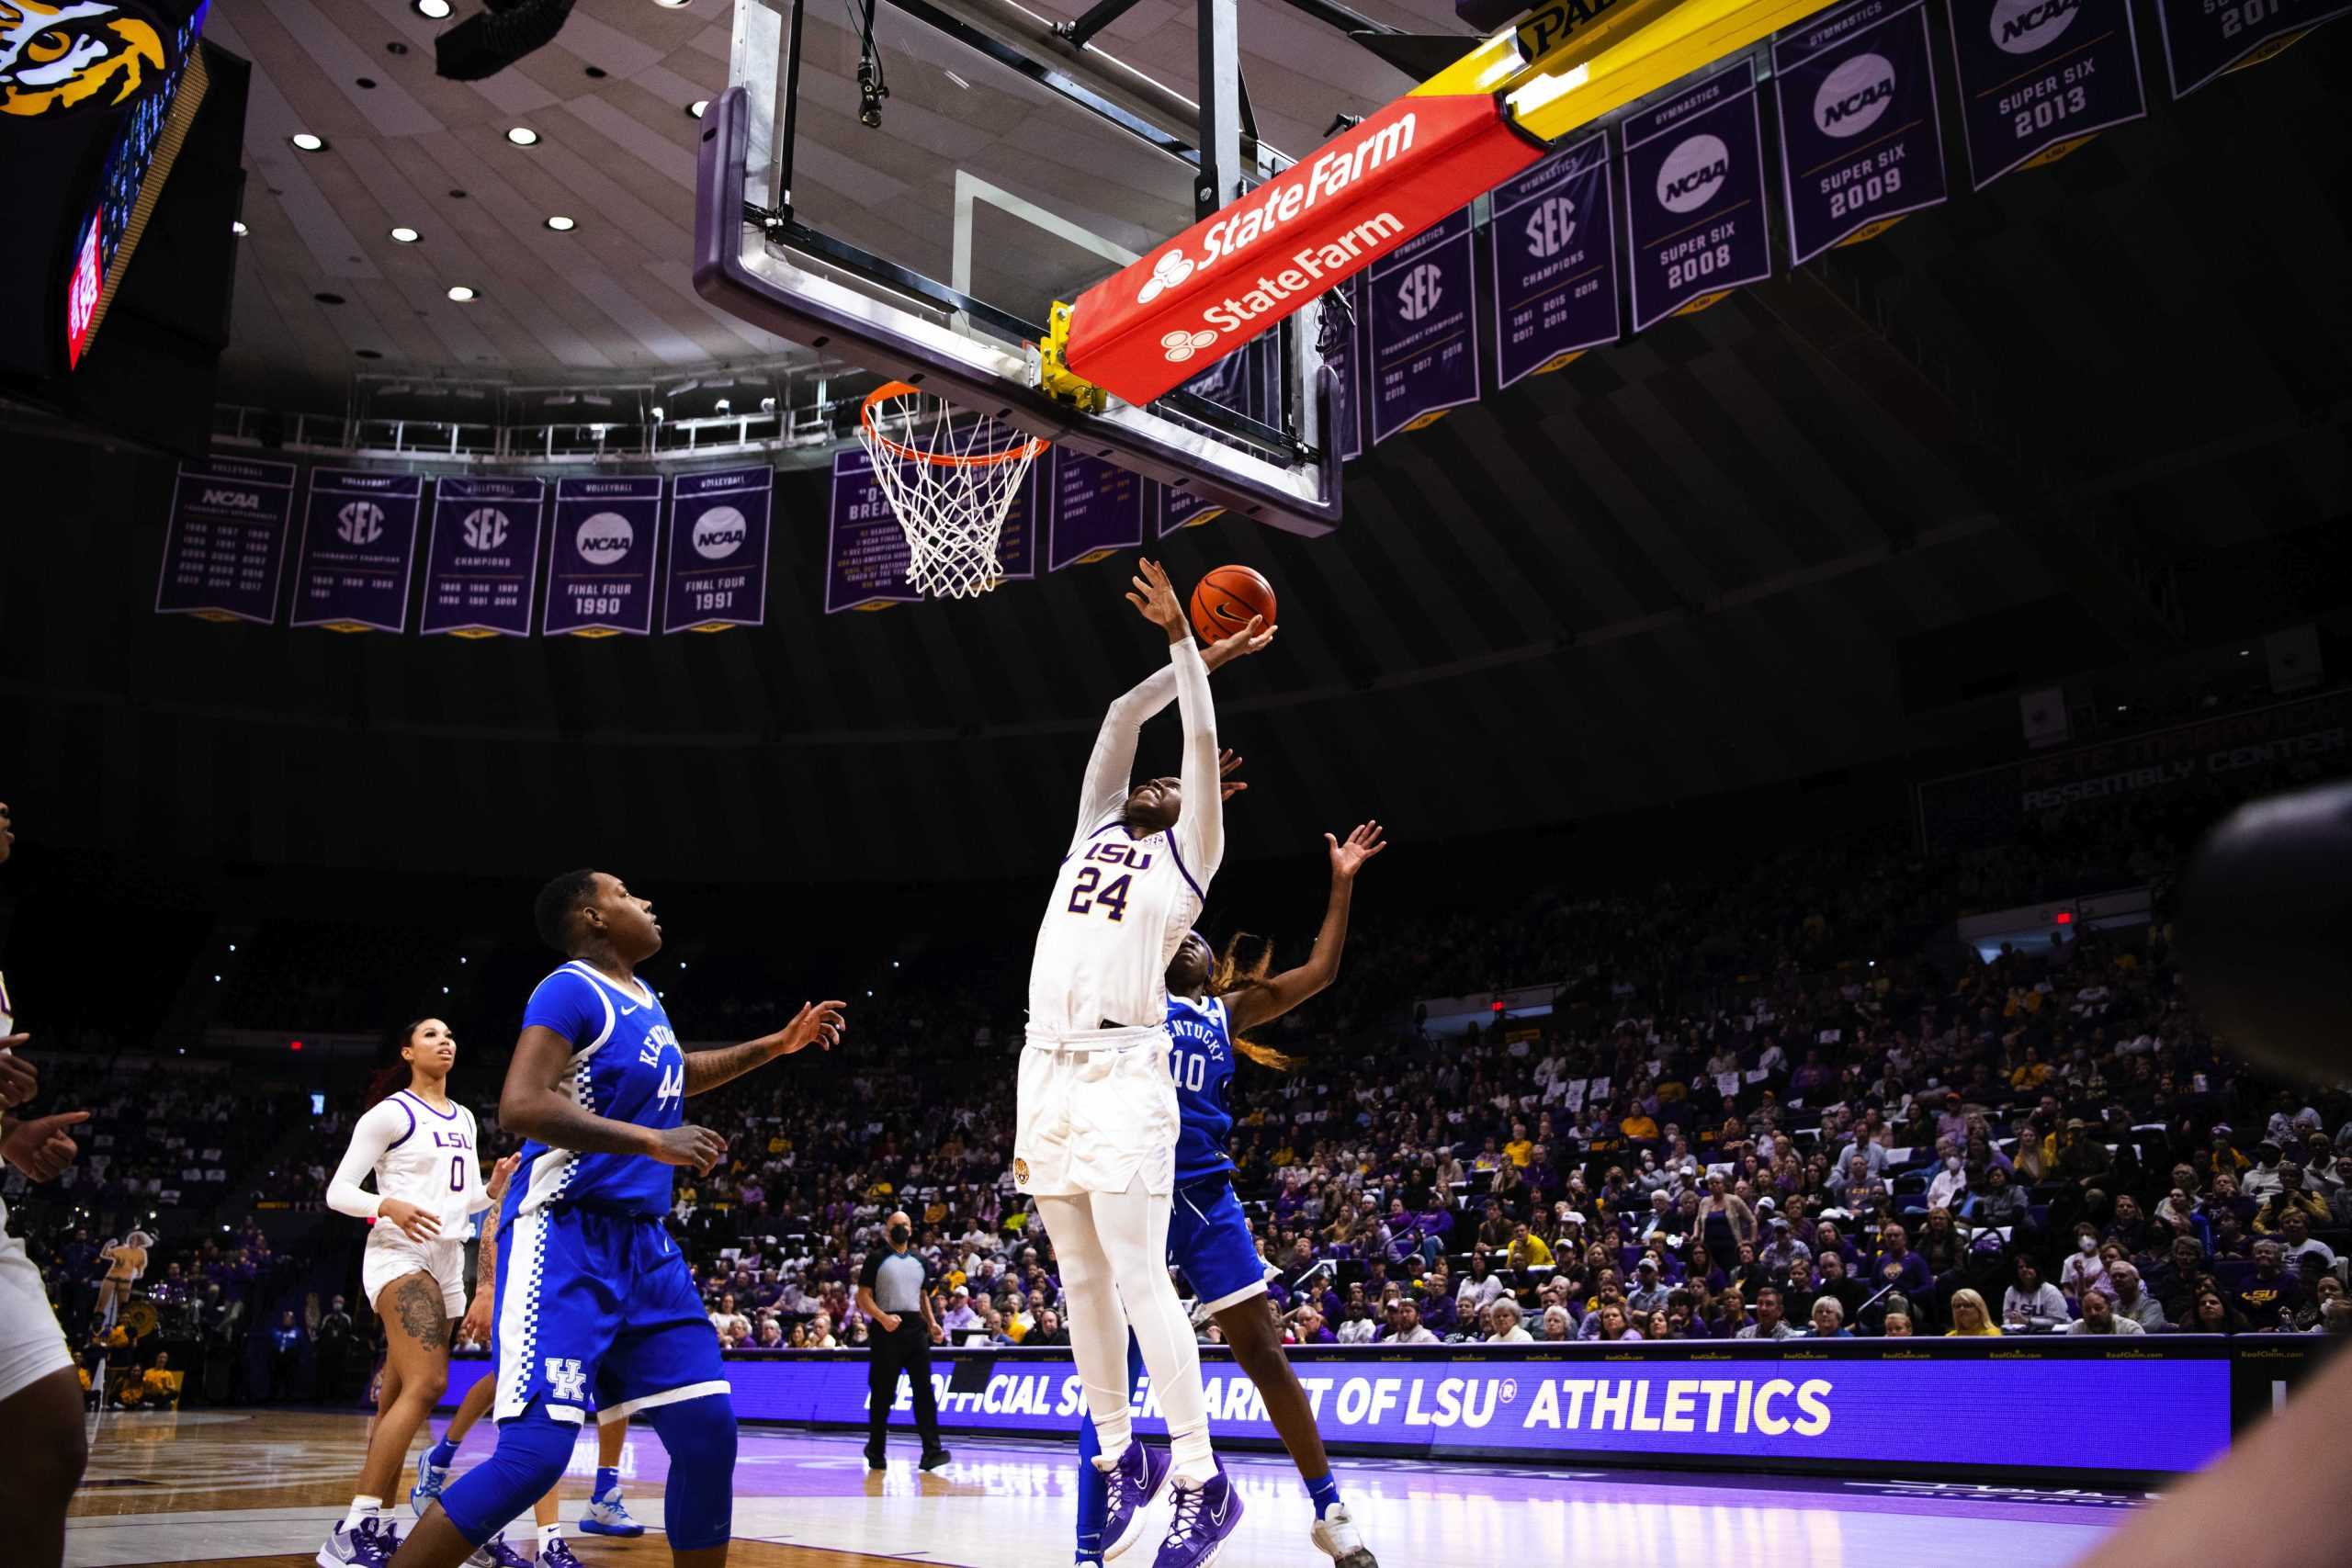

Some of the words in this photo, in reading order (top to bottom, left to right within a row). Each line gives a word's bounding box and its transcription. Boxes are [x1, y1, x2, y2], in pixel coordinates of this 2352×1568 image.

[1809, 2, 1883, 47] GYMNASTICS
[1655, 85, 1721, 126] GYMNASTICS
[1824, 77, 1893, 129] NCAA
[1999, 73, 2057, 117] SUPER
[2063, 57, 2096, 87] SIX
[2014, 85, 2087, 140] 2013
[1664, 157, 1726, 203] NCAA
[1820, 158, 1873, 196] SUPER
[1877, 142, 1907, 169] SIX
[1828, 166, 1903, 220] 2009
[1394, 225, 1445, 259] GYMNASTICS
[1525, 197, 1577, 258] SEC
[1659, 233, 1707, 266] SUPER
[1710, 220, 1736, 244] SIX
[1522, 249, 1586, 288] CHAMPIONS
[1667, 243, 1732, 289] 2008
[1397, 263, 1442, 321] SEC
[201, 489, 260, 511] NCAA
[585, 482, 633, 493] VOLLEYBALL
[700, 474, 745, 490] VOLLEYBALL
[336, 500, 386, 546] SEC
[462, 507, 511, 551] SEC
[582, 536, 632, 551] NCAA
[697, 529, 744, 547] NCAA
[454, 556, 512, 568] CHAMPIONS
[567, 583, 600, 596] FINAL
[602, 583, 632, 596] FOUR
[685, 579, 716, 593] FINAL
[718, 575, 746, 591] FOUR
[695, 591, 733, 612] 1991
[575, 597, 622, 615] 1990
[1084, 841, 1153, 871] LSU
[1066, 865, 1135, 923] 24
[1163, 1019, 1225, 1063] ENTUCKY
[656, 1064, 684, 1112] 44
[1173, 1049, 1206, 1093] 10
[433, 1131, 472, 1151] LSU
[449, 1156, 465, 1192] 0
[1989, 1349, 2042, 1359] RoofClaim.com
[2105, 1349, 2164, 1359] RoofClaim.com
[2241, 1348, 2304, 1359] RoofClaim.com
[1336, 1377, 1403, 1425] OF
[1521, 1379, 1834, 1437] ATHLETICS
